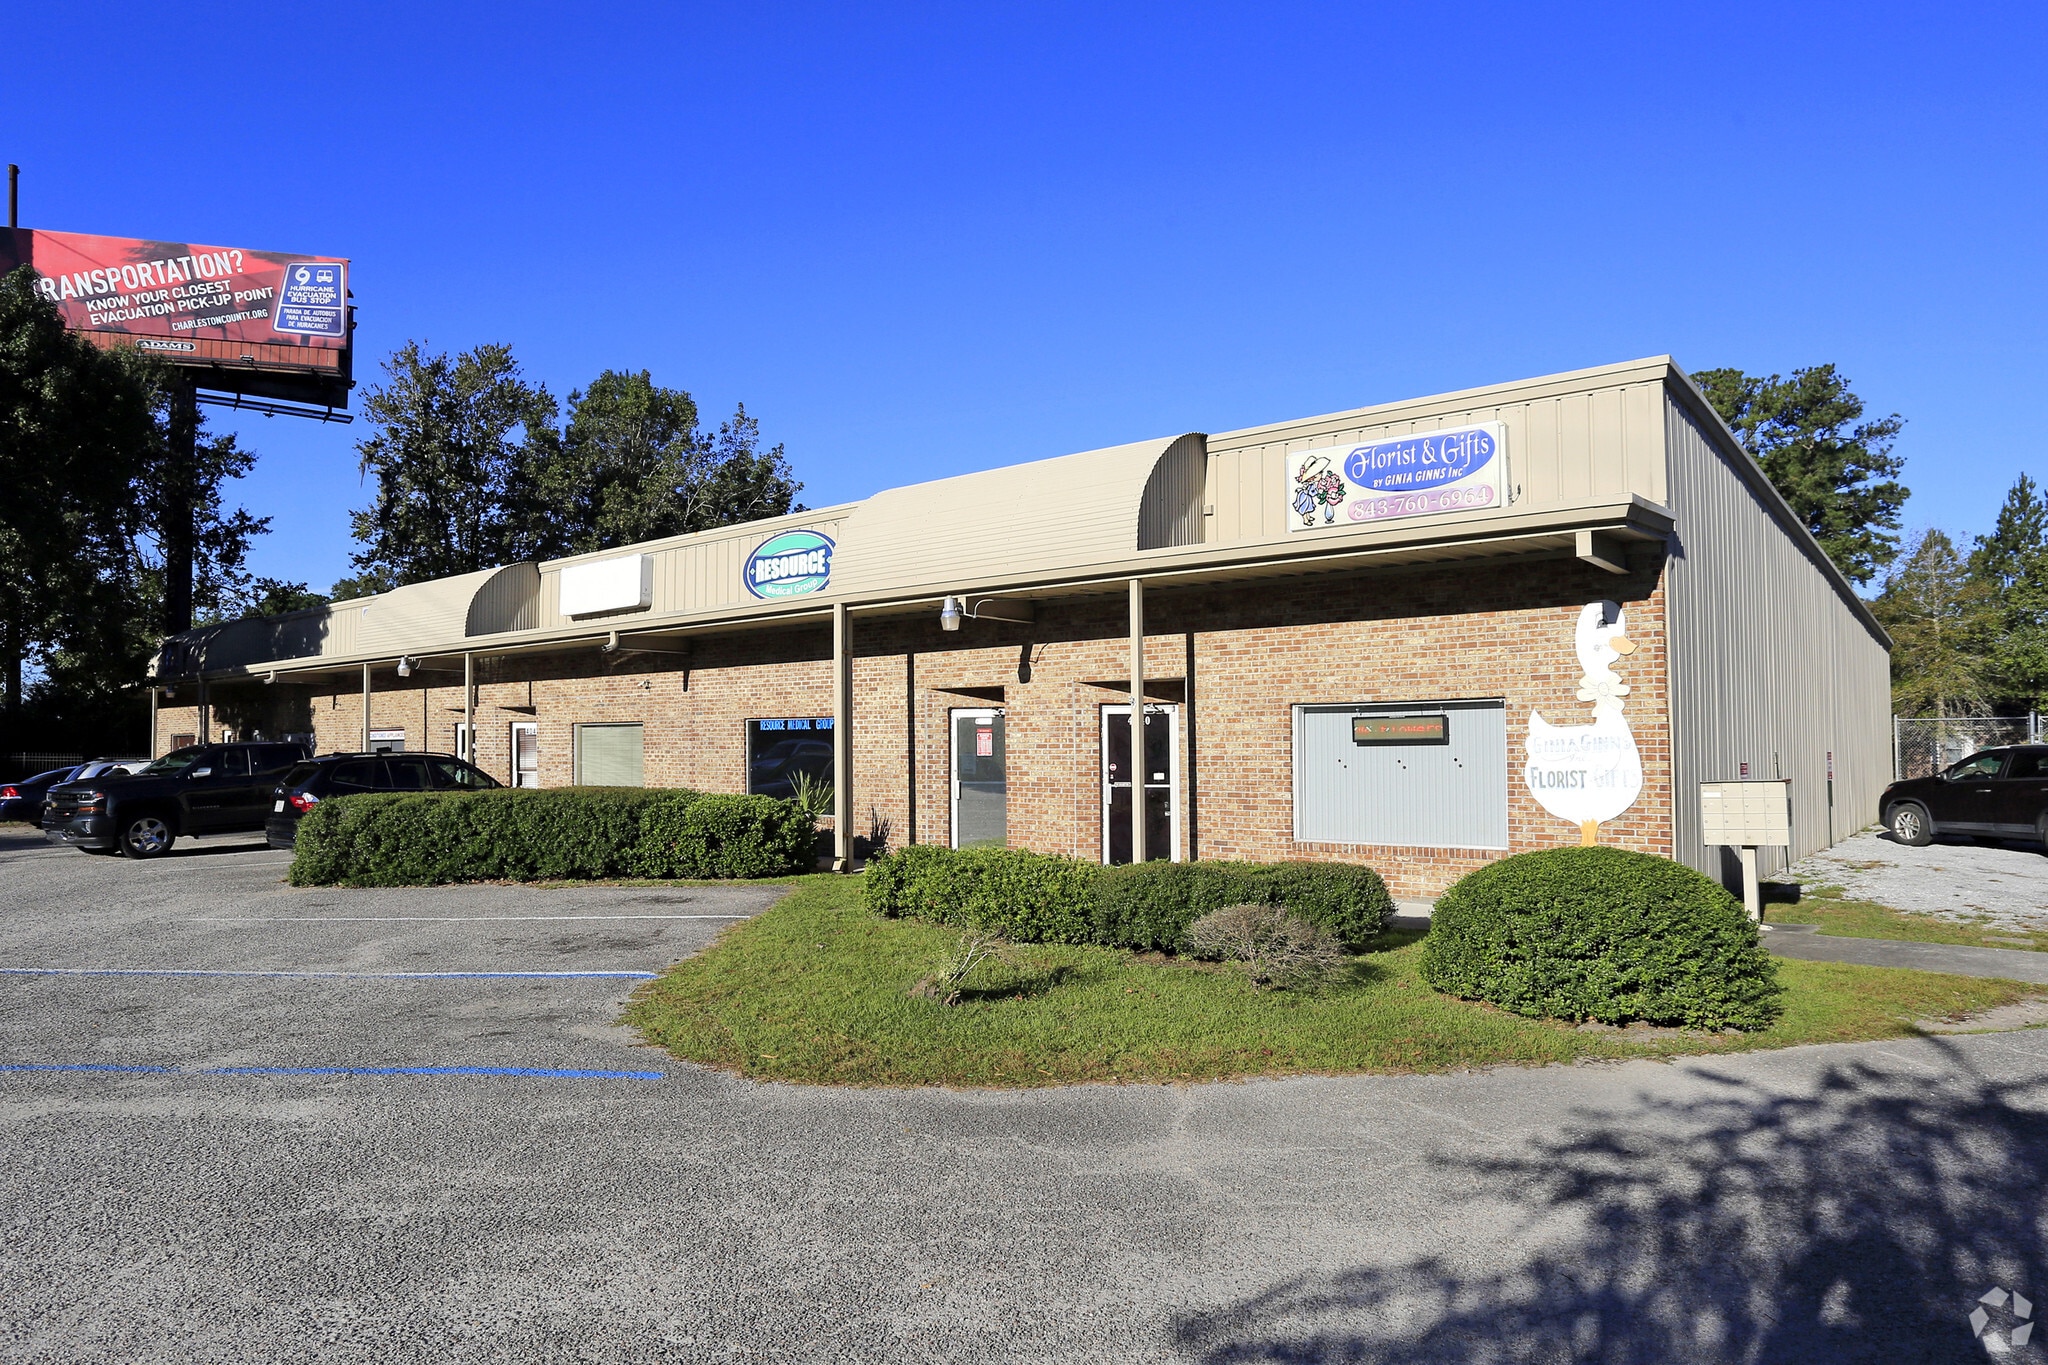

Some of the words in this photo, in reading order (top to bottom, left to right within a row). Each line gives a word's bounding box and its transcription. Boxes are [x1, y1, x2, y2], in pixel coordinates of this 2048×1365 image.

[35, 250, 243, 302] RANSPORTATION?
[86, 295, 129, 312] KNOW
[131, 289, 170, 305] YOUR
[172, 280, 231, 299] CLOSEST
[89, 303, 175, 325] EVACUATION
[178, 294, 232, 312] PICK-UP
[235, 286, 274, 303] POINT
[287, 291, 337, 299] EVACUATION
[172, 309, 268, 331] CHARLESTONCOUNTY.ORG
[141, 341, 191, 350] ADAMS
[1352, 444, 1416, 479] Florist
[1422, 439, 1437, 464] &
[1441, 431, 1489, 468] Gifts
[1385, 471, 1413, 487] GINIA
[1415, 466, 1446, 483] GINNS
[1353, 487, 1489, 519] 843-760-6964
[755, 548, 826, 583] RESOURCE
[765, 584, 793, 595] Medical
[794, 579, 818, 594] Group
[760, 719, 786, 730] RESOURCE
[787, 719, 811, 730] MEDICAL
[815, 718, 834, 730] GROUP
[1530, 766, 1587, 789] FLORIST
